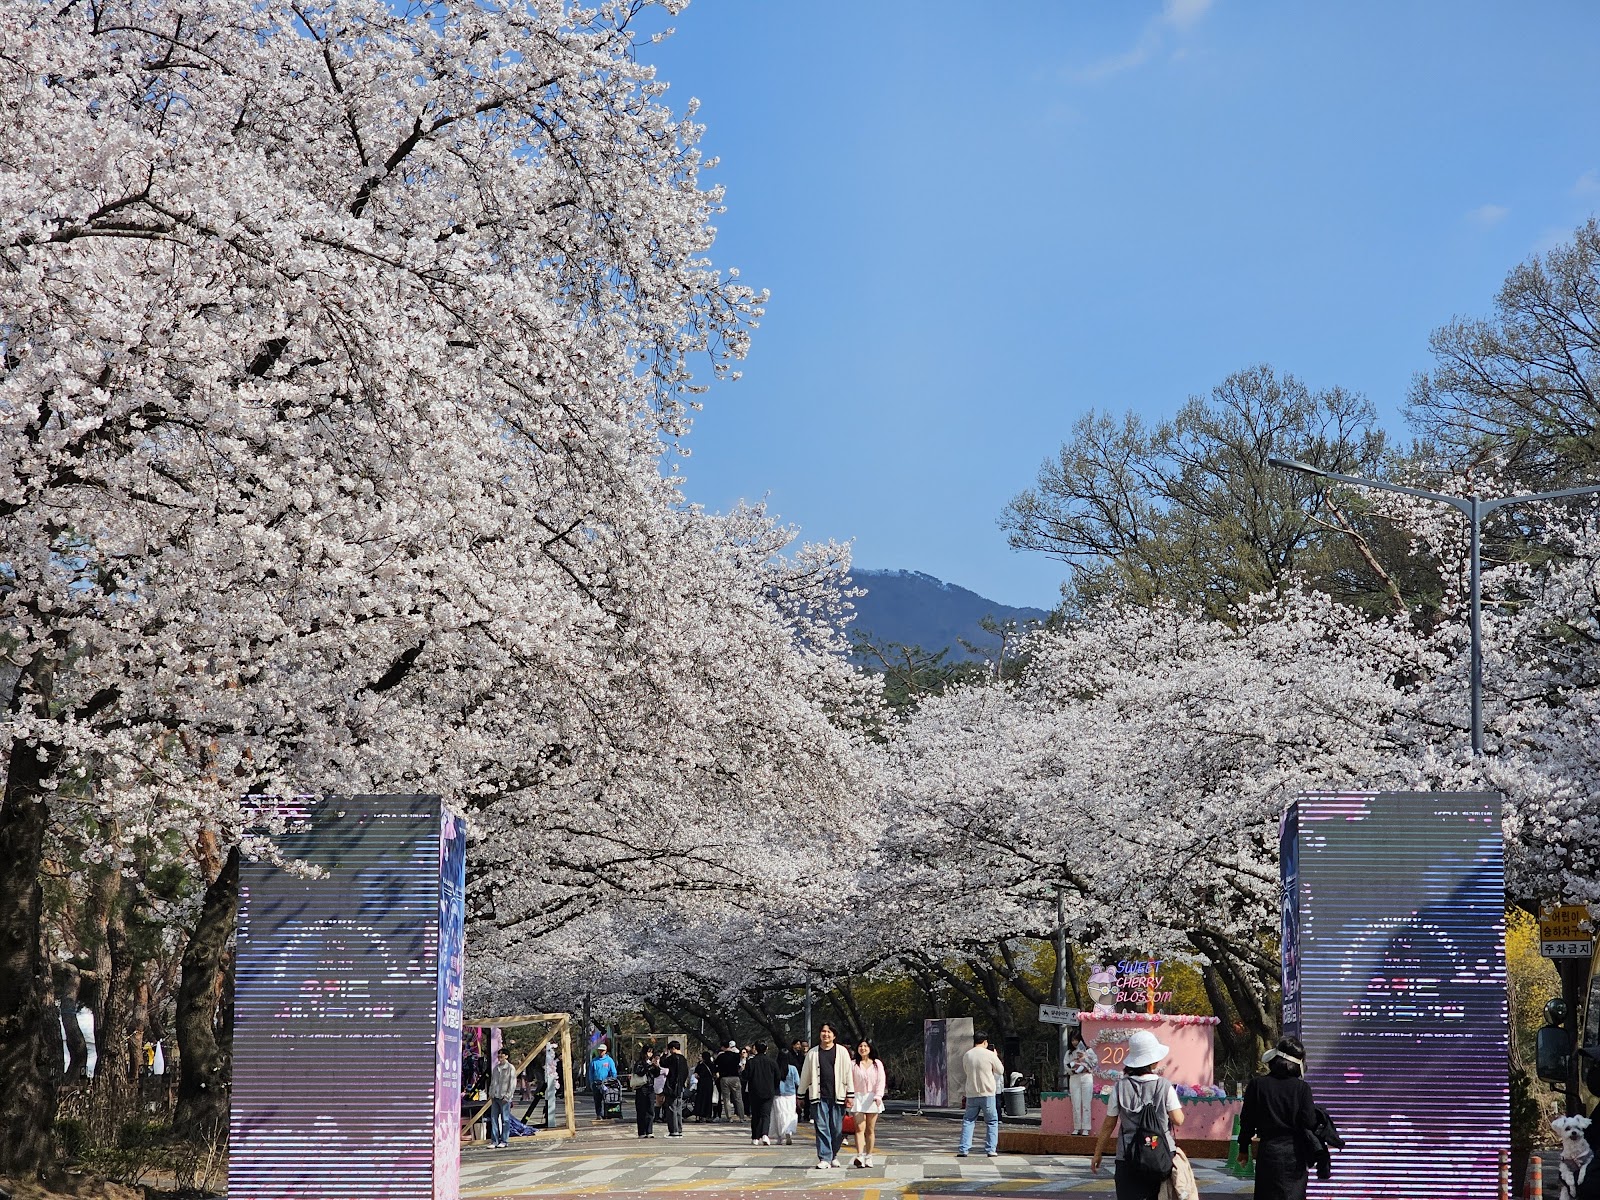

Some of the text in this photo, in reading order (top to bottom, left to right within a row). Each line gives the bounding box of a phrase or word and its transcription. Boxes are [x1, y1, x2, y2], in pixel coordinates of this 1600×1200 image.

[1552, 911, 1579, 923] 어린이
[1545, 943, 1589, 954] 주차금지
[1116, 960, 1163, 974] SWEET
[1116, 976, 1164, 989] CHERRY
[1116, 991, 1172, 1003] BLOSSOM
[1101, 1046, 1130, 1064] 20
